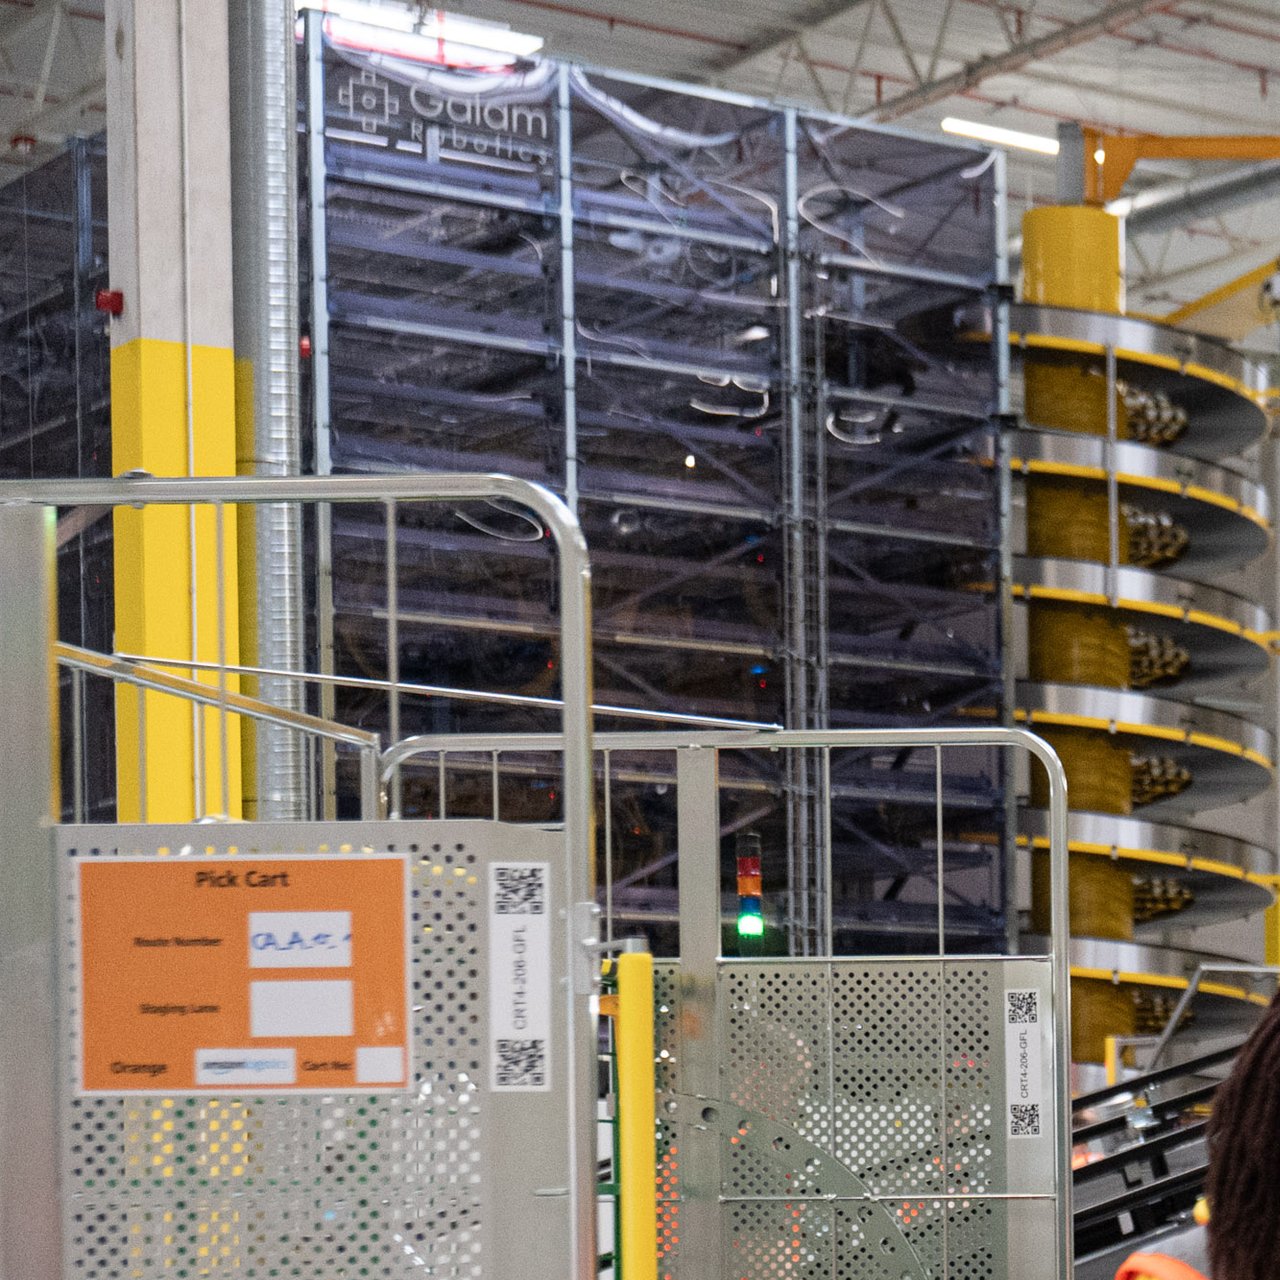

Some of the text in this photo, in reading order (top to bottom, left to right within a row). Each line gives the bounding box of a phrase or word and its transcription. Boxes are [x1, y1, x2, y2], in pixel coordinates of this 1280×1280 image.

[195, 870, 289, 887] Pick Cart
[110, 1061, 168, 1077] Orange
[1019, 1029, 1029, 1099] CRT4-206-GFL
